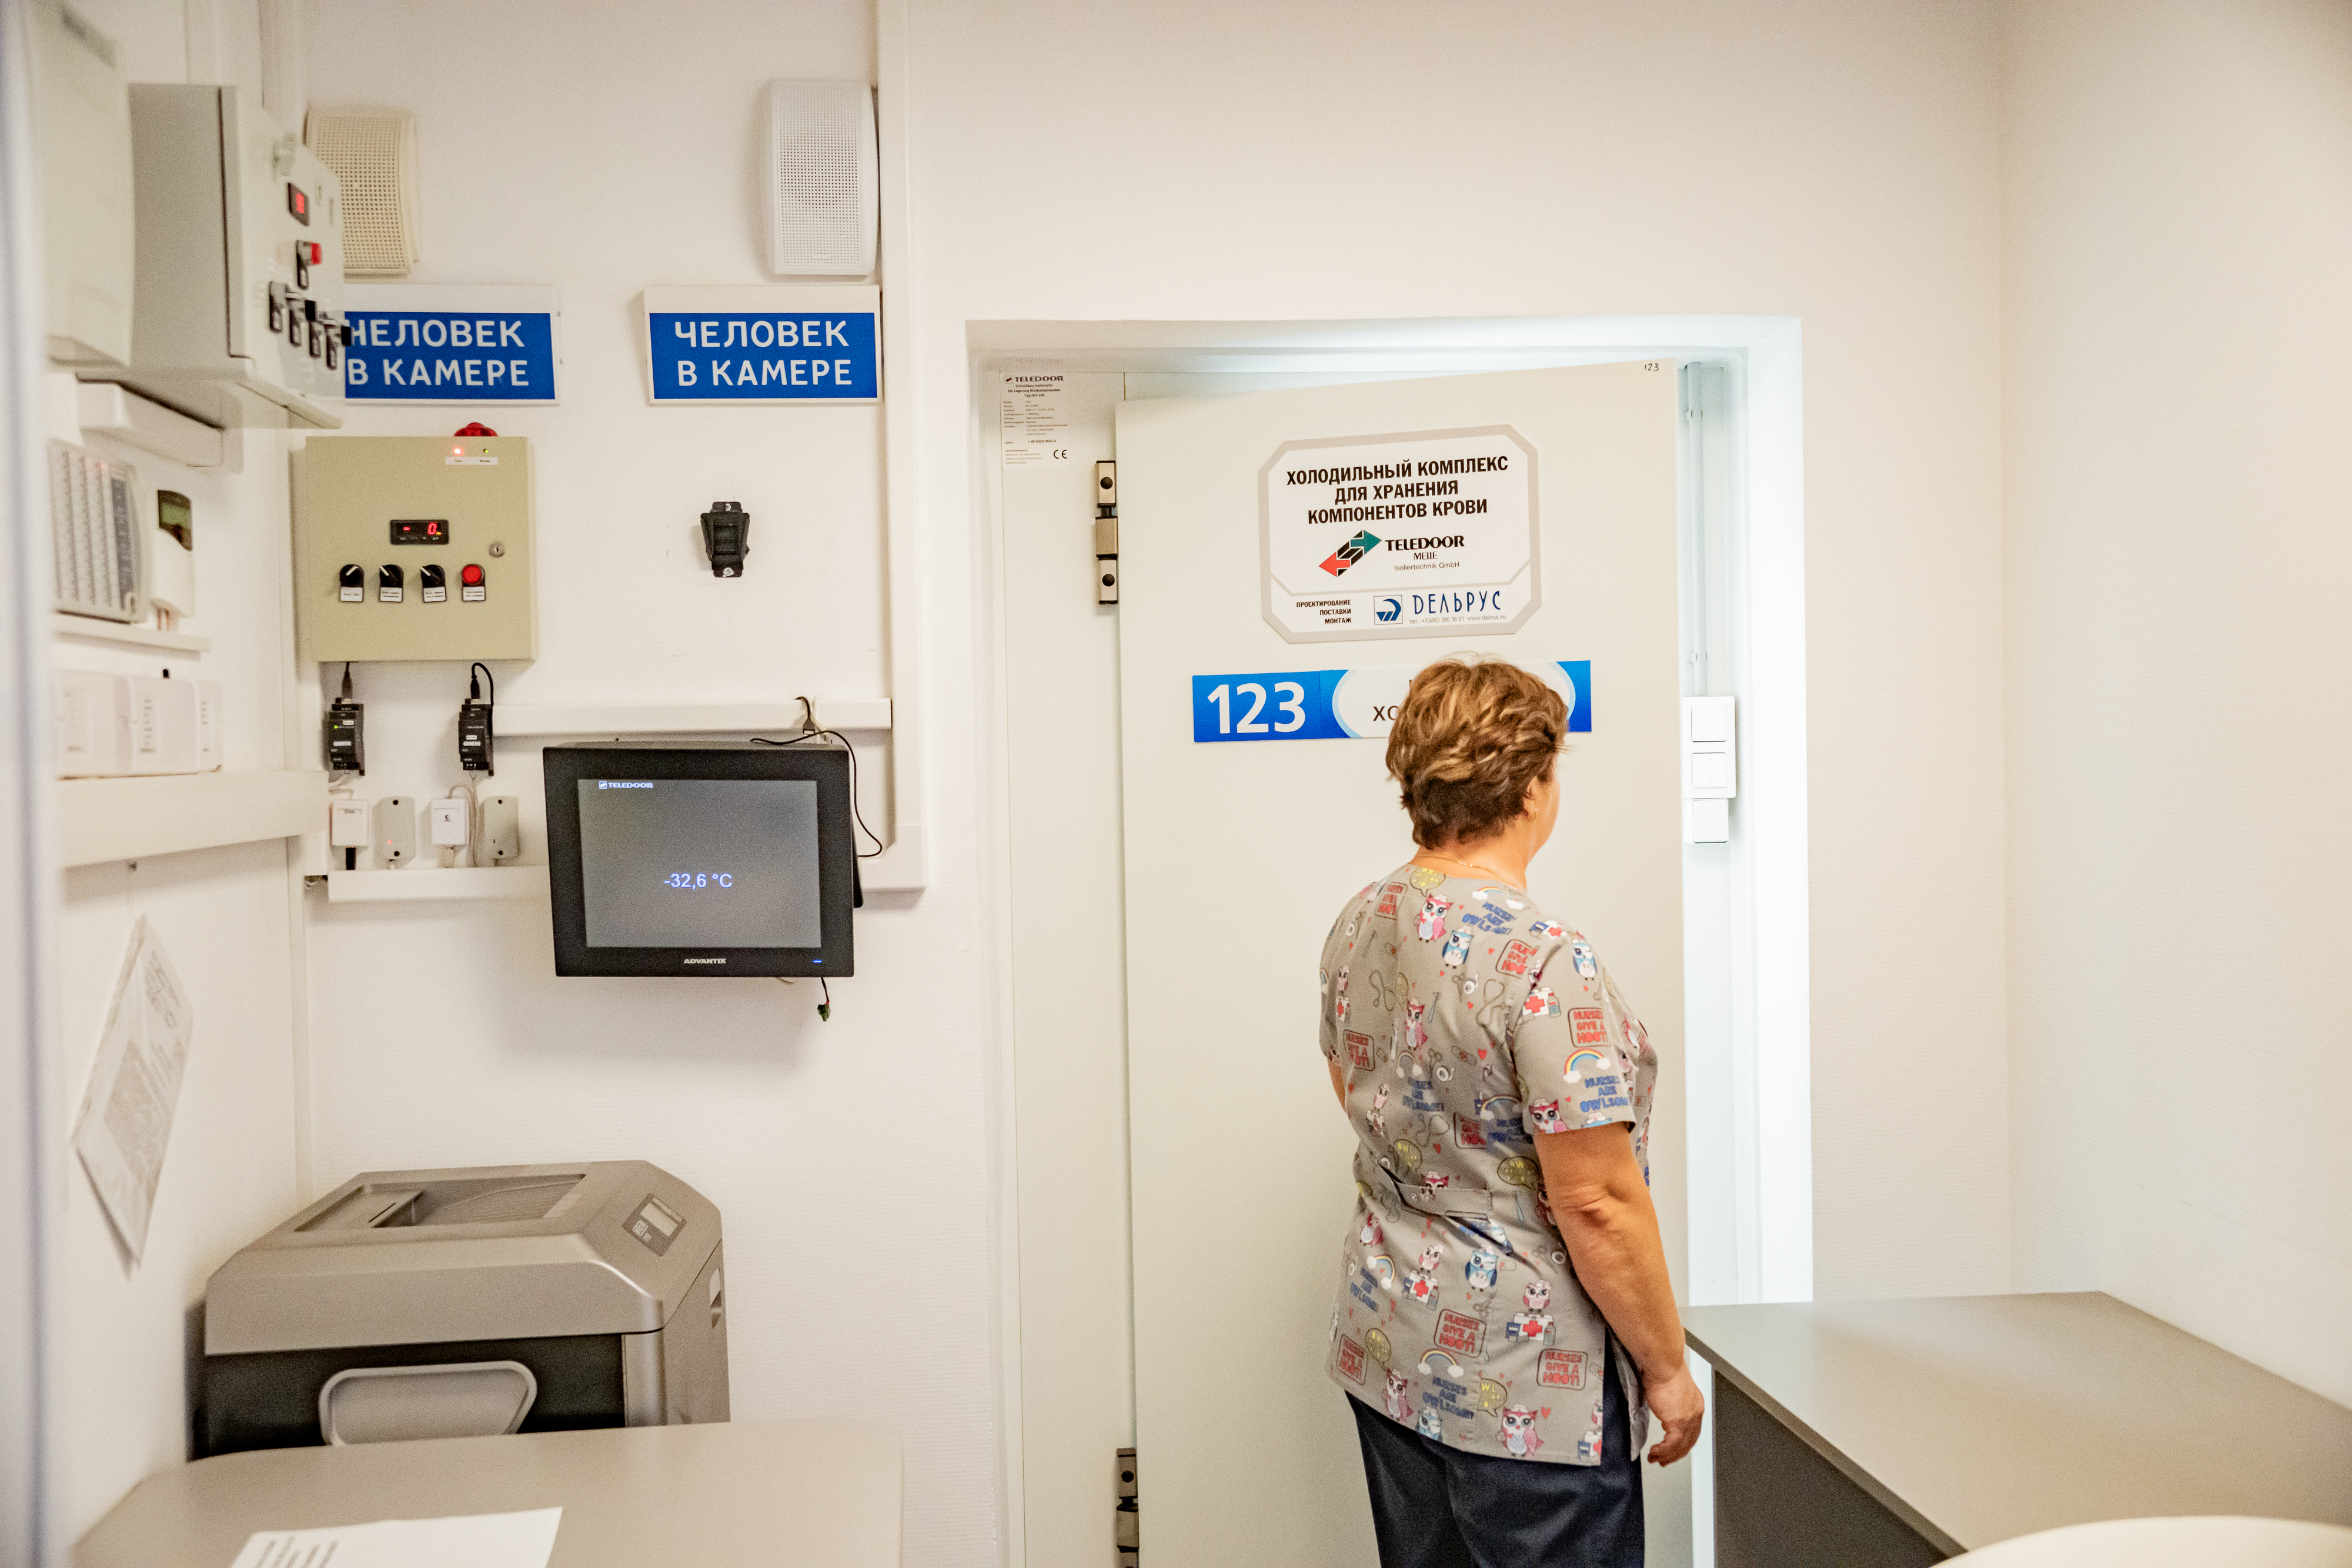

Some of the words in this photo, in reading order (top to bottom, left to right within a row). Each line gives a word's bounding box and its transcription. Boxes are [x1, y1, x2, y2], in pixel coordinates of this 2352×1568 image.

[674, 320, 849, 347] ЧЕЛОВЕК
[348, 359, 369, 385] В
[383, 358, 529, 386] КАМЕРЕ
[677, 360, 697, 386] В
[711, 359, 852, 386] КАМЕРЕ
[1644, 363, 1659, 372] 123
[1287, 459, 1412, 486] ХОЛОДИЛЬНЫЙ
[1418, 456, 1508, 477] КОМПЛЕКС
[1334, 486, 1368, 506] ДЛЯ
[1372, 480, 1458, 500] ХРАНЕНИЯ
[1308, 503, 1428, 524] КОМПОНЕНТОВ
[1432, 499, 1488, 517] КРОВИ
[1385, 535, 1465, 551] TELEDOOR
[1414, 551, 1438, 560] MELLE
[1394, 563, 1437, 571] Isoliertechnik
[1296, 599, 1351, 607] ПРОЕКТИРОВАНИЕ
[1207, 681, 1306, 734] 123
[663, 872, 707, 890] -32,6
[711, 872, 733, 888] °C
[1443, 1323, 1465, 1338] GIVE
[1466, 1331, 1475, 1342] A
[1545, 1362, 1569, 1373] GIVE
[1572, 1364, 1579, 1374] A
